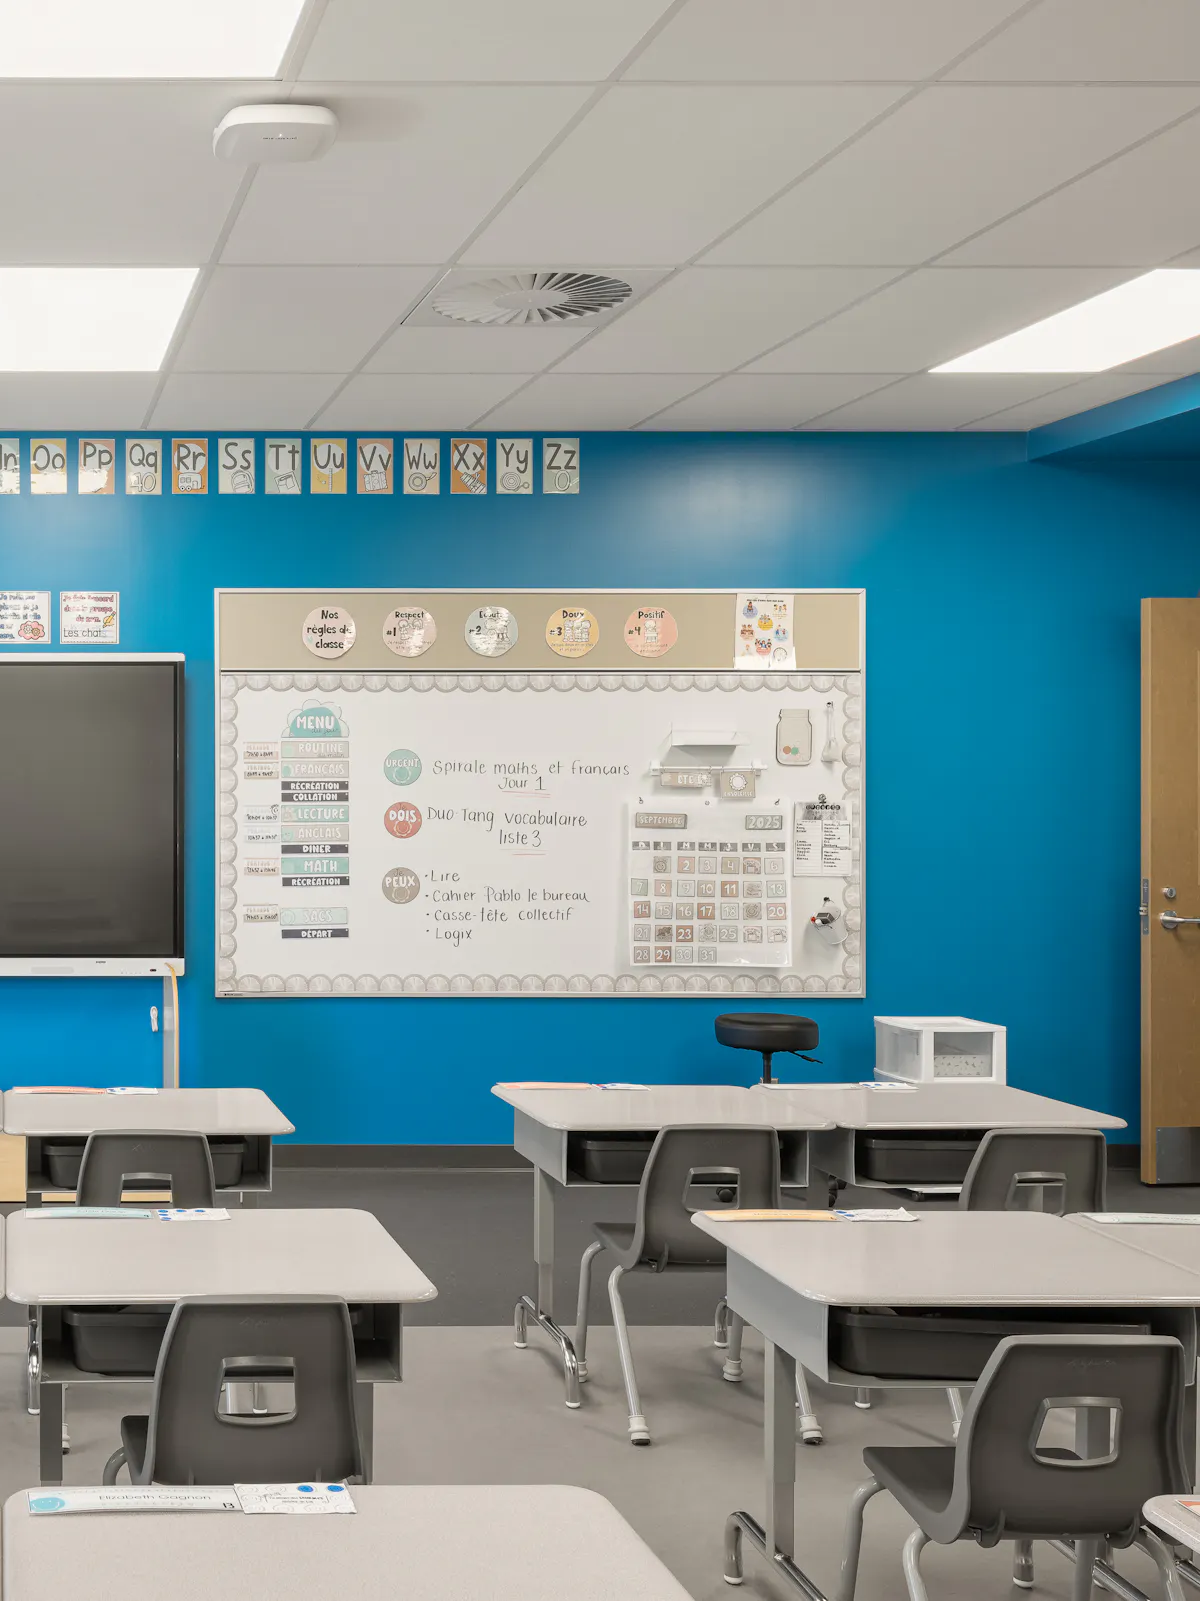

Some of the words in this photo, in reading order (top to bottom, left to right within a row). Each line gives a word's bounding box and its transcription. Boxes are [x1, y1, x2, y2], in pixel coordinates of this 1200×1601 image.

[83, 442, 113, 468] Pp
[130, 444, 158, 473] Qq
[176, 444, 206, 470] Rr
[223, 442, 251, 470] Ss
[269, 444, 299, 470] Tt
[313, 444, 345, 470] Uu
[360, 446, 391, 471] Vv
[406, 443, 437, 470] Ww
[454, 444, 484, 470] Xx
[500, 443, 528, 474] Yy
[546, 444, 576, 470] Zz
[321, 610, 338, 620] Nos
[395, 611, 424, 620] Respect
[638, 610, 665, 619] Positif
[307, 624, 336, 636] règles
[386, 627, 397, 637] #1
[628, 627, 641, 635] #4
[315, 638, 344, 649] classe
[296, 716, 335, 729] MENU
[298, 743, 343, 753] ROUTINE
[432, 760, 487, 775] Spirale
[493, 760, 538, 774] maths
[548, 760, 563, 774] et
[498, 776, 528, 790] Jour
[535, 776, 546, 790] 1
[298, 809, 345, 820] LECTURE
[389, 809, 417, 822] DOIS
[504, 809, 588, 826] vocabulaire
[639, 815, 682, 825] SEPTEMBRE
[749, 816, 780, 829] 2025
[298, 828, 342, 838] ANGLAIS
[499, 829, 528, 845] liste
[532, 830, 542, 847] 3
[304, 860, 338, 872] MATH
[683, 860, 690, 870] 2
[727, 860, 734, 870] 4
[430, 870, 461, 882] Lire
[292, 878, 340, 886] RÉCRÉATION
[386, 876, 416, 888] PEUX
[637, 882, 643, 892] 7
[432, 889, 476, 902] Cahier
[484, 886, 521, 902] Pablo
[528, 888, 538, 902] le
[543, 888, 591, 902] bureau
[660, 883, 666, 894] 8
[700, 884, 713, 894] 10
[724, 884, 736, 894] 11
[771, 885, 783, 894] 13
[434, 907, 509, 922] Casse-tête
[518, 907, 574, 921] collectif
[636, 904, 649, 914] 14
[658, 905, 670, 916] 15
[678, 906, 691, 916] 16
[700, 906, 712, 916] 17
[724, 906, 736, 916] 18
[768, 906, 784, 917] 20
[302, 910, 333, 923] SACS
[301, 930, 333, 938] DÉPART
[436, 927, 472, 947] Logix
[636, 928, 648, 938] 21
[678, 929, 692, 939] 23
[721, 928, 736, 939] 25
[636, 950, 649, 960] 28
[656, 950, 670, 960] 29
[676, 950, 690, 961] 30
[702, 950, 714, 960] 31
